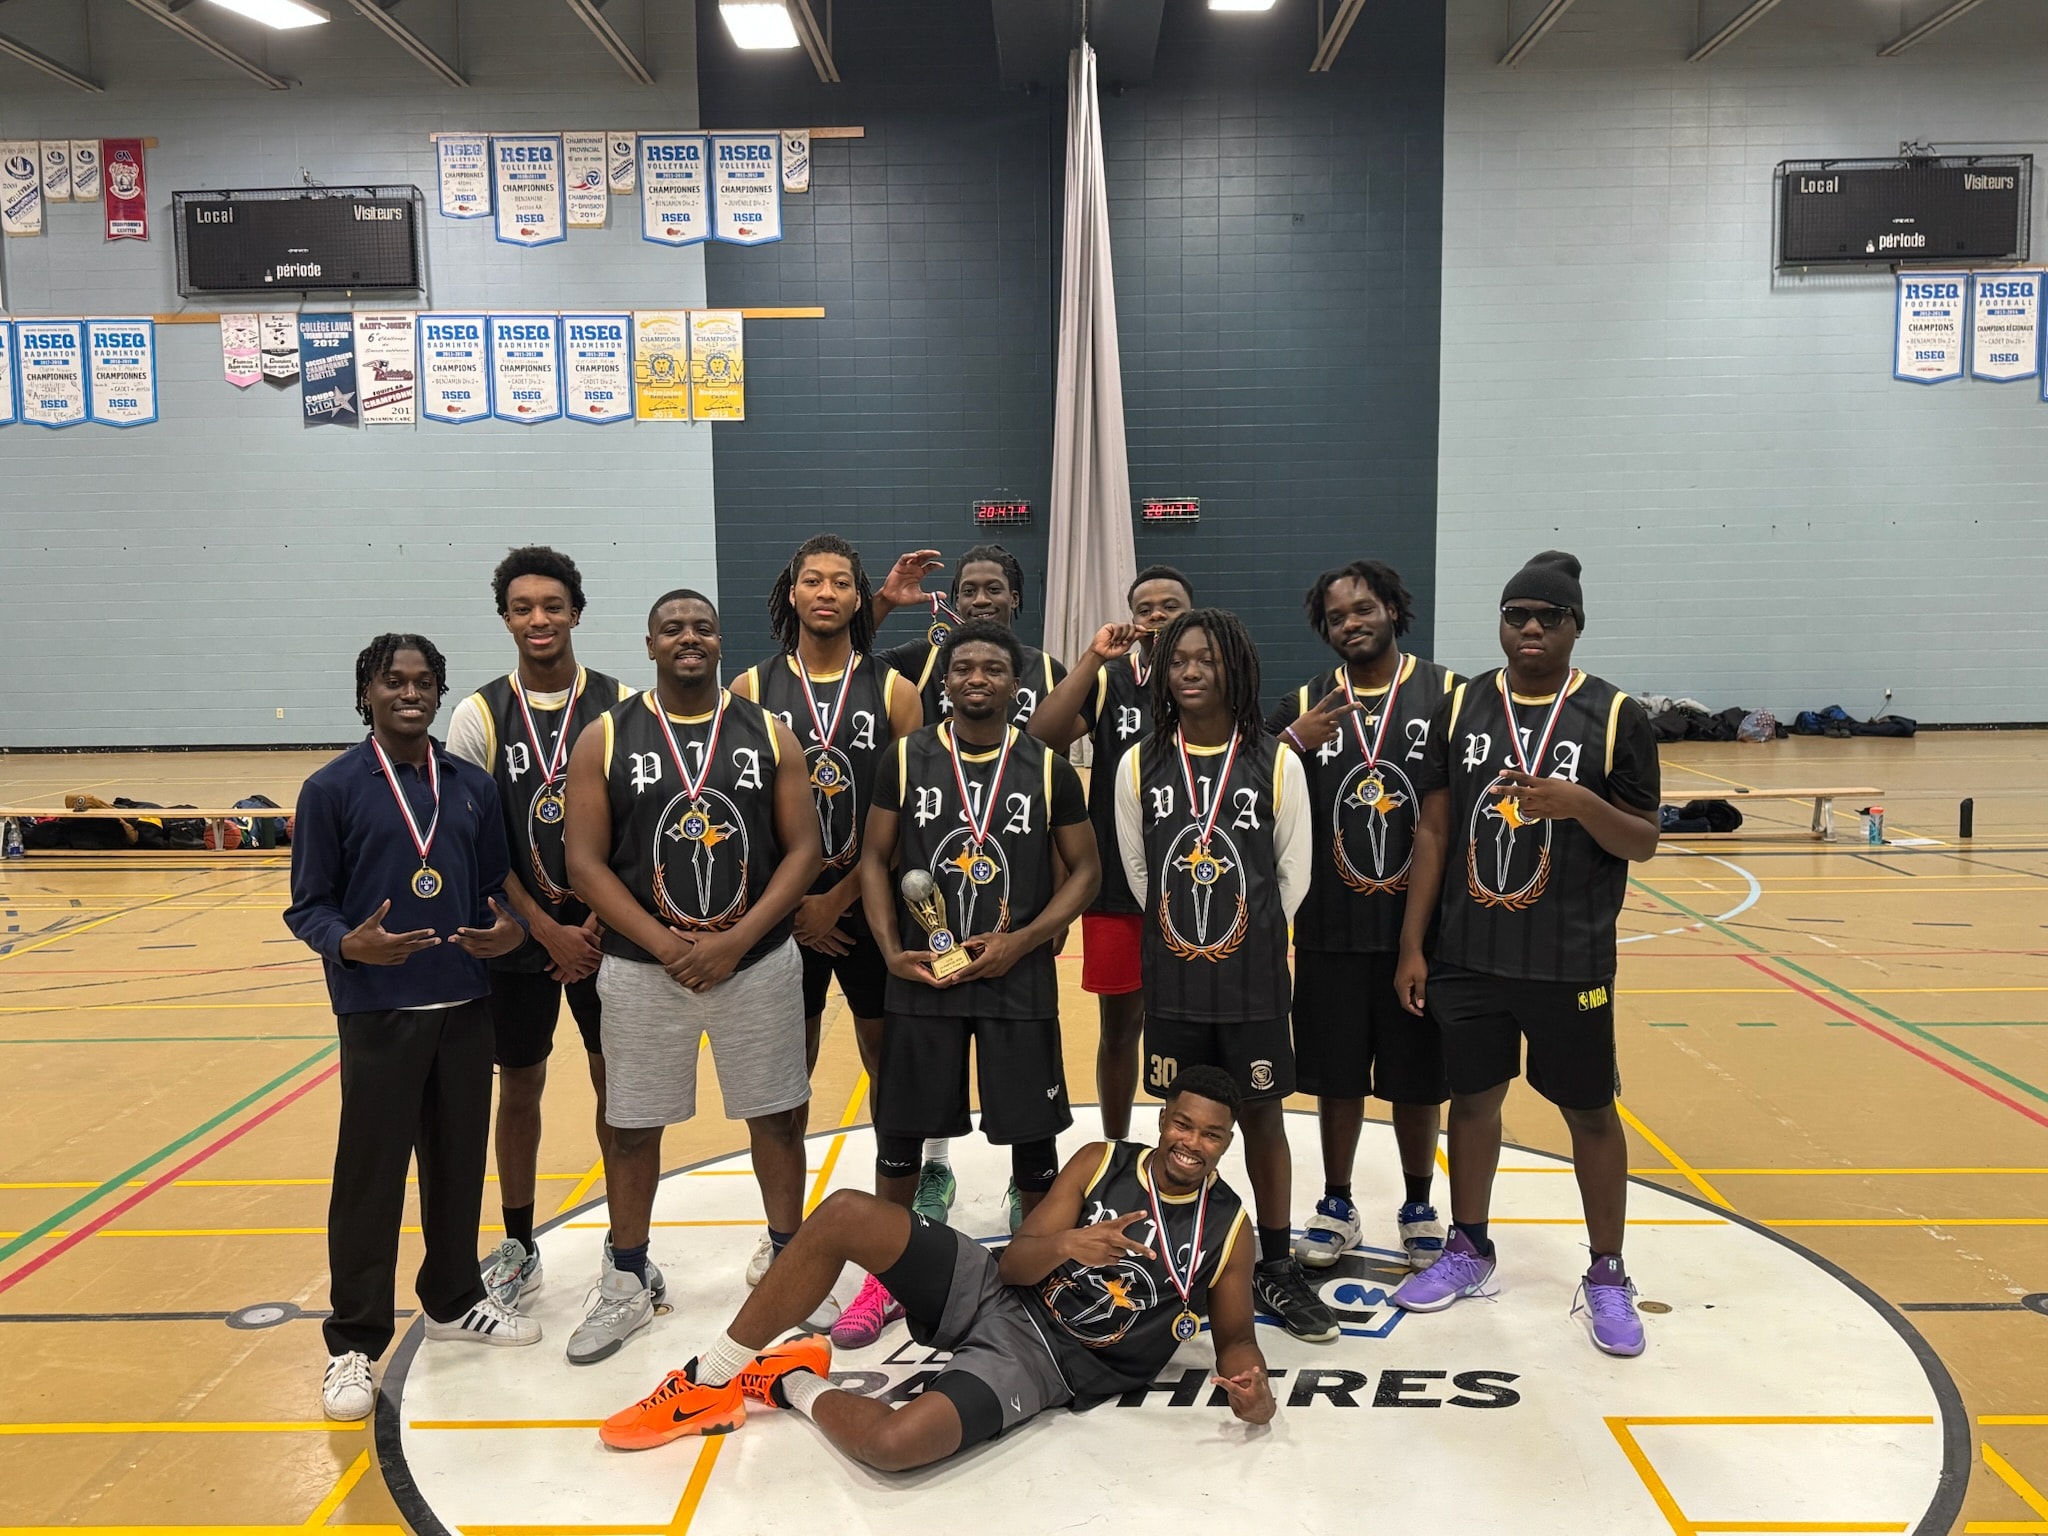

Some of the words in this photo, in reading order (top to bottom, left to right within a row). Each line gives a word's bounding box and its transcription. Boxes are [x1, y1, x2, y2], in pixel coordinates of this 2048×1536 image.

[444, 144, 482, 156] RSEQ
[501, 147, 553, 162] RSEQ
[647, 146, 700, 161] RSEQ
[720, 145, 772, 161] RSEQ
[503, 184, 554, 192] CHAMPIONNES
[649, 186, 700, 194] CHAMPIONNES
[1800, 176, 1839, 194] Local
[1964, 174, 2014, 191] Visiteurs
[197, 207, 233, 223] Local
[354, 204, 403, 221] Visiteurs
[516, 214, 545, 223] RSEQ
[662, 213, 691, 222] RSEQ
[734, 213, 762, 222] RSEQ
[1879, 232, 1926, 250] période
[277, 262, 322, 280] période
[1906, 284, 1959, 300] RSEQ
[1980, 282, 2034, 299] RSEQ
[300, 321, 330, 332] COLLÈGE
[331, 322, 353, 332] LAVAL
[360, 322, 412, 330] SAINT-JOSEPH
[427, 325, 480, 340] RSEQ
[498, 325, 551, 340] RSEQ
[570, 325, 622, 340] RSEQ
[1909, 323, 1954, 332] CHAMPIONS
[2006, 323, 2034, 332] RÉGIONAUX
[24, 334, 76, 349] RSEQ
[94, 333, 146, 348] RSEQ
[1915, 351, 1945, 360] RSEQ
[1989, 353, 2019, 362] RSEQ
[306, 360, 349, 375] CHAMPIONNES
[432, 364, 477, 372] CHAMPIONS
[500, 364, 552, 372] CHAMPIONNES
[27, 373, 78, 381] CHAMPIONNES
[97, 372, 147, 380] CHAMPIONNES
[305, 391, 334, 403] Coupe
[442, 391, 471, 400] RSEQ
[513, 391, 542, 400] RSEQ
[585, 391, 614, 400] RSEQ
[41, 400, 69, 409] RSEQ
[109, 399, 138, 408] RSEQ
[392, 407, 412, 415] 201
[978, 506, 1014, 518] 20:47
[849, 710, 877, 750] A
[1116, 704, 1142, 741] P
[504, 741, 531, 784] P
[1462, 733, 1492, 773] P
[1549, 740, 1583, 784] A
[628, 752, 663, 795] P
[732, 748, 764, 791] A
[914, 786, 943, 828] P
[1003, 792, 1033, 835] A
[1231, 788, 1261, 831] A
[1589, 986, 1608, 1009] NBA
[1150, 1054, 1178, 1089] 30
